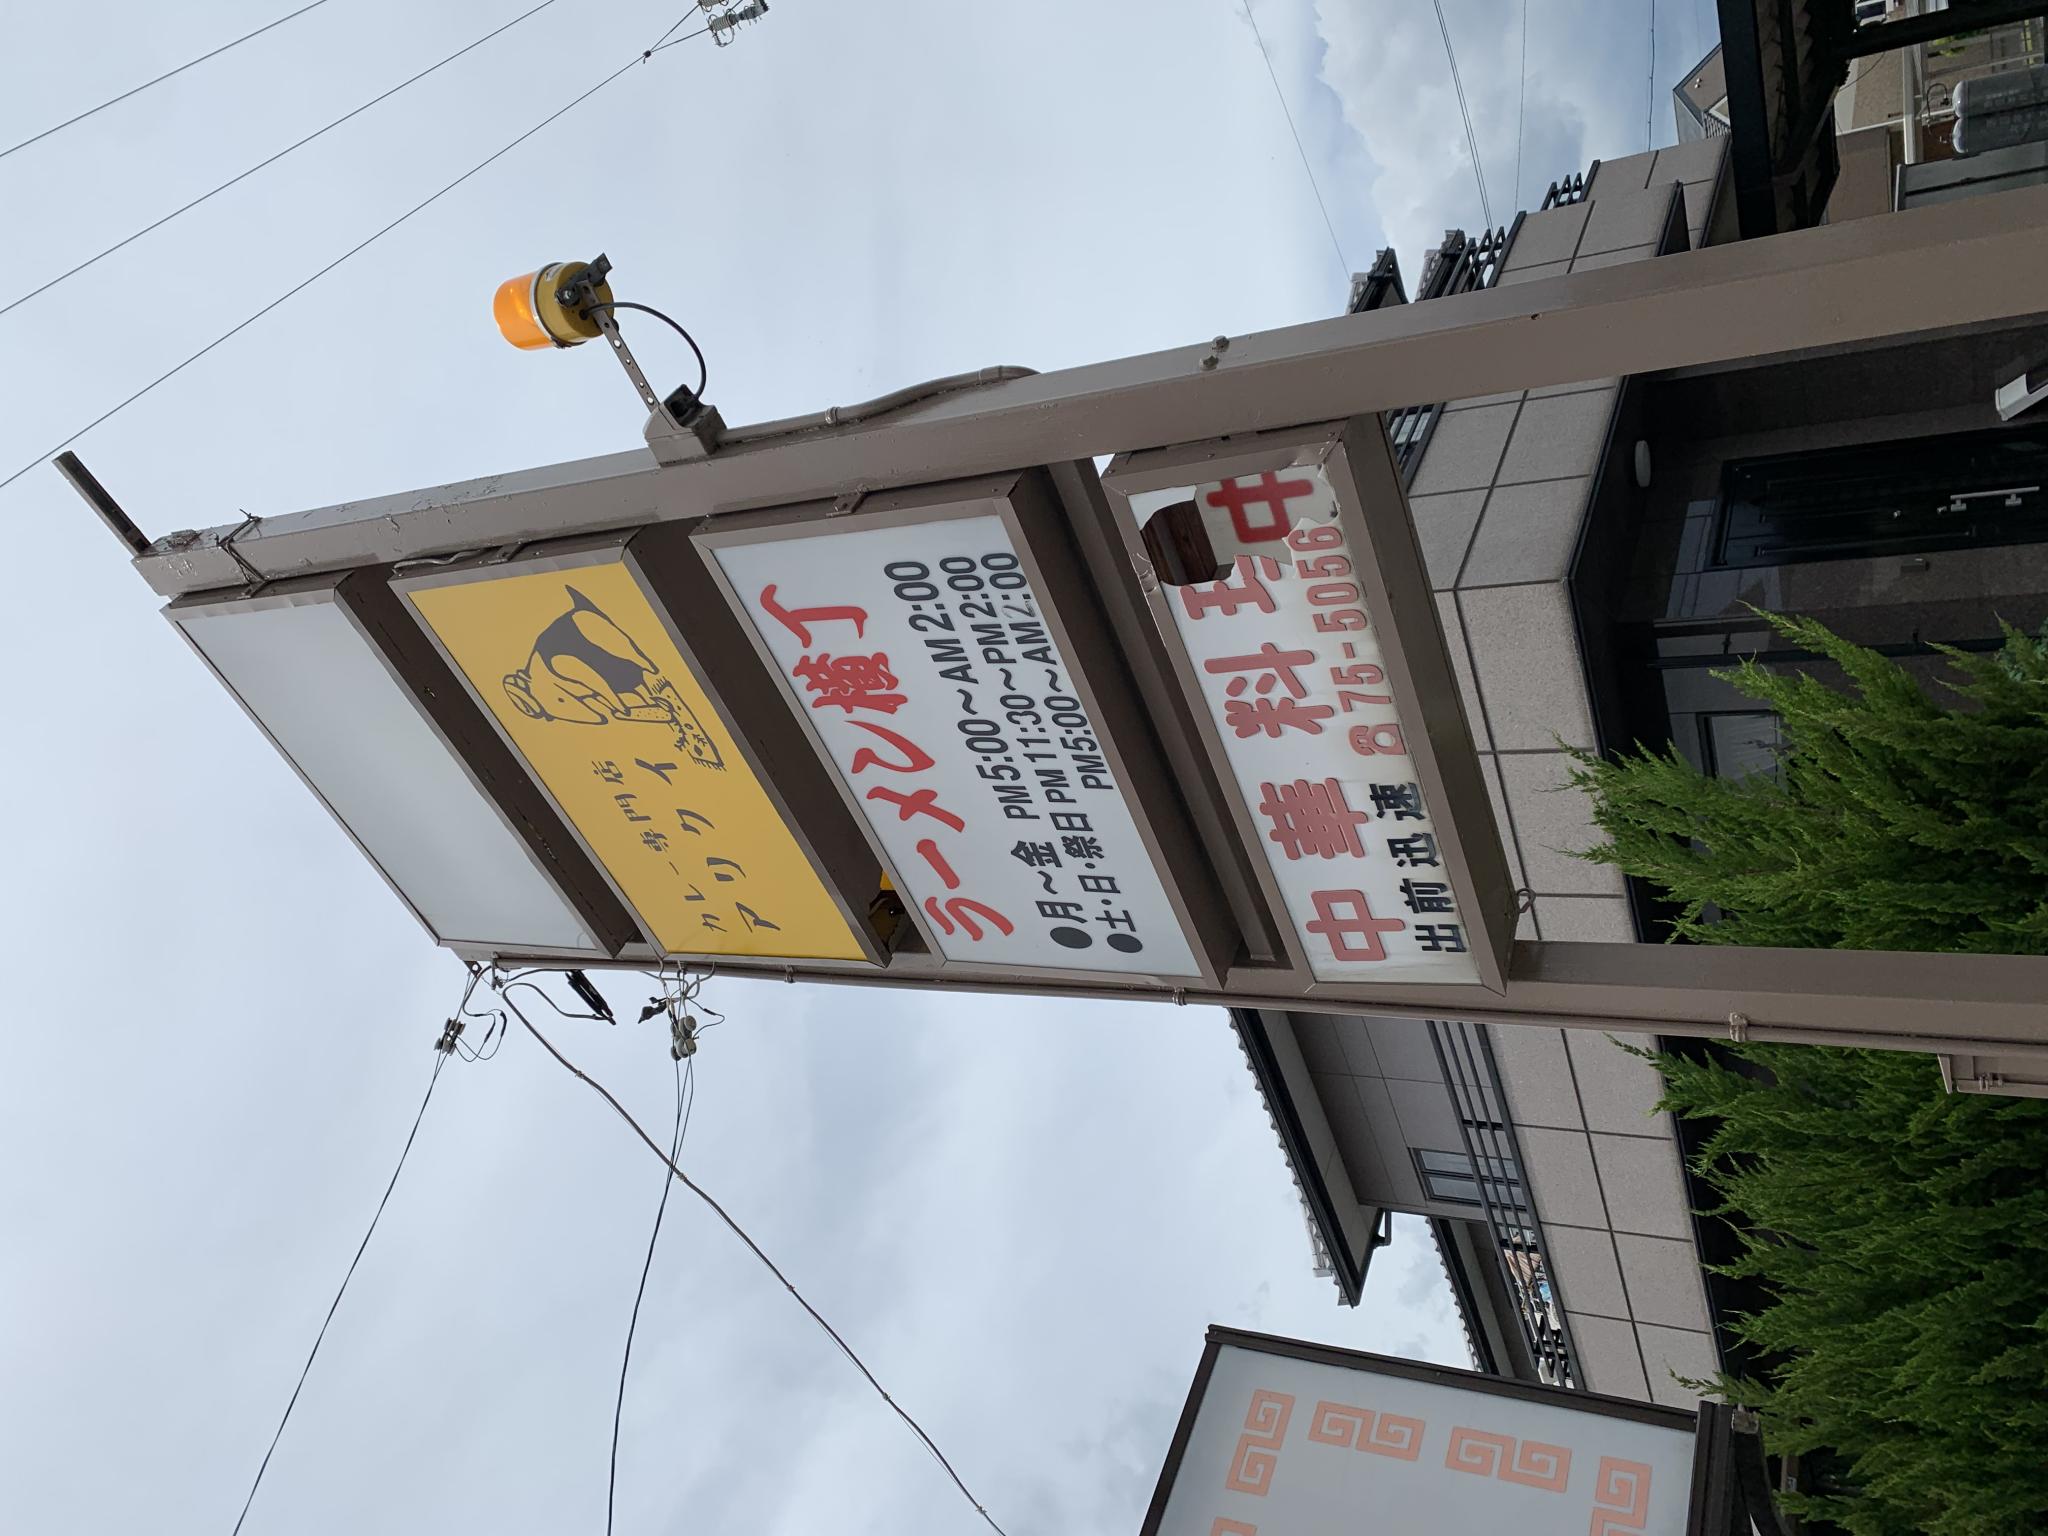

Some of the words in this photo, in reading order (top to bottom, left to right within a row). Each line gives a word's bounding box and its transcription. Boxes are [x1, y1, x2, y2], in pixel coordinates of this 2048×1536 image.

[592, 760, 727, 932] カレー専門店
[635, 758, 780, 932] アリクイ
[760, 584, 1014, 941] ラーメン横丁
[1370, 782, 1466, 952] 出前迅速
